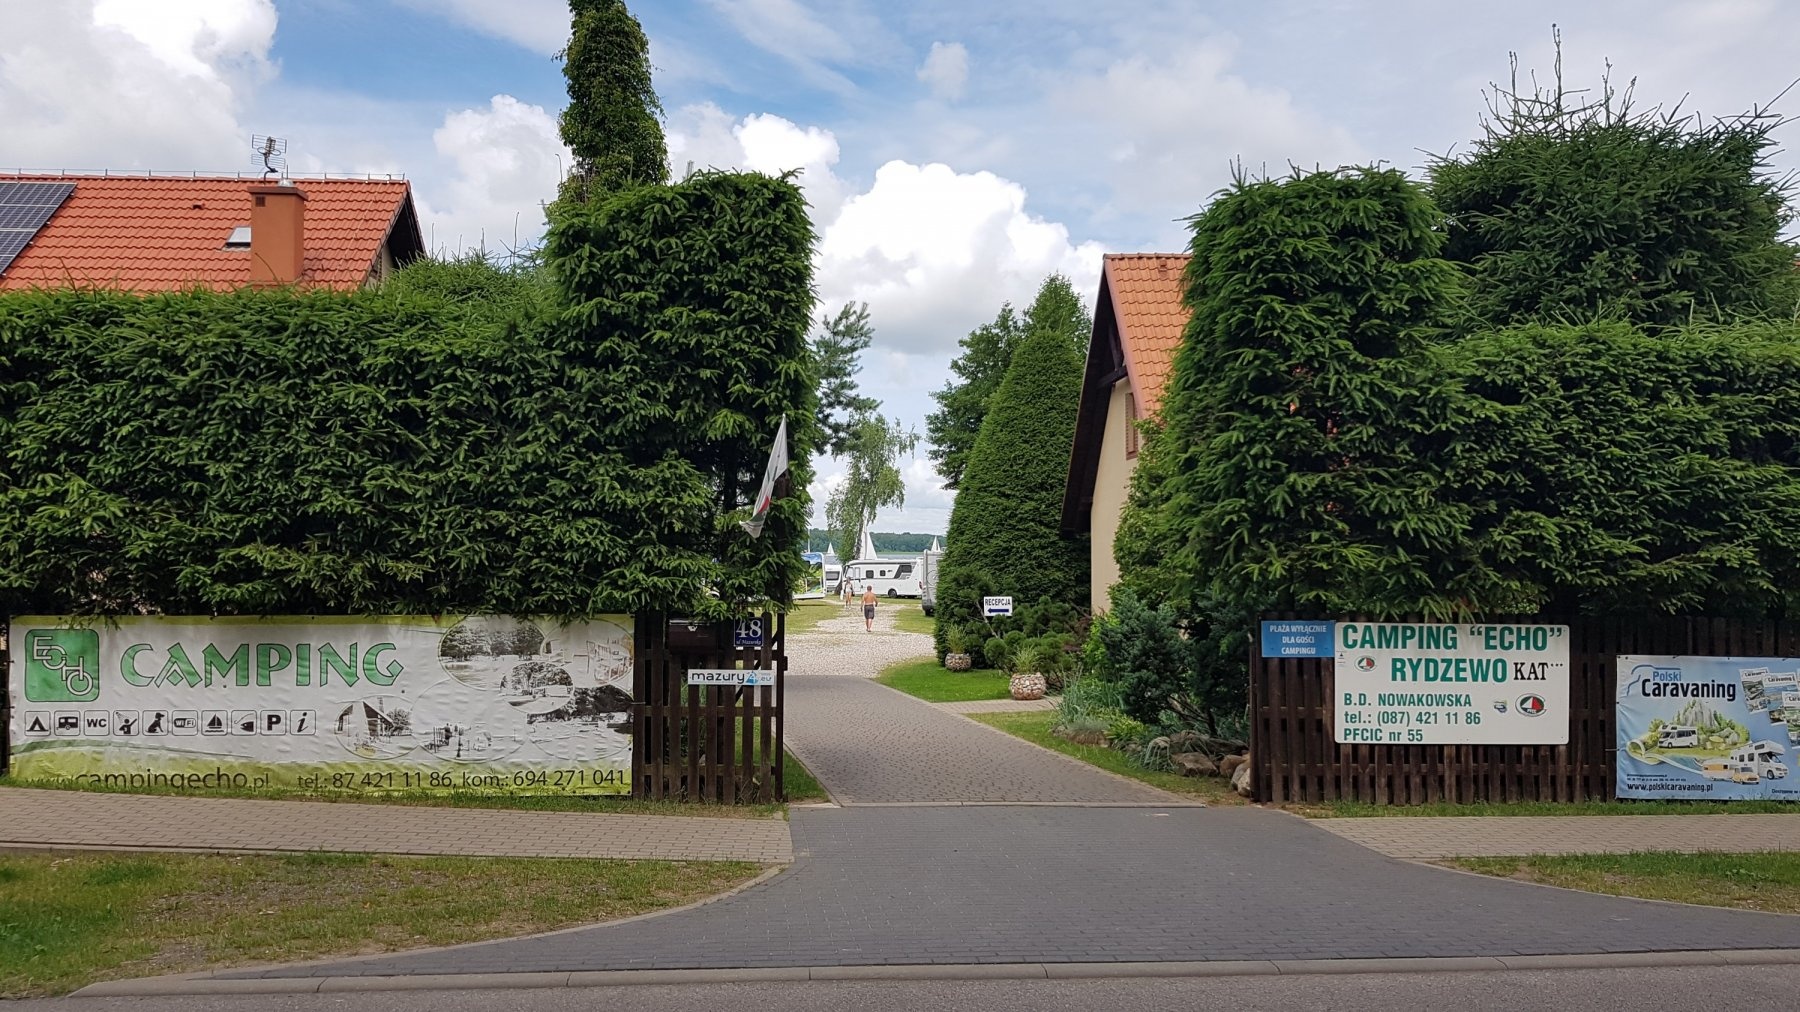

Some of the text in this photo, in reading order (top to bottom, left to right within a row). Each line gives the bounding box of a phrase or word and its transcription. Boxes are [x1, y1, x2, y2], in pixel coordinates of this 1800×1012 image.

[985, 598, 1011, 606] RECEPCJA
[736, 618, 762, 638] 48
[1282, 636, 1295, 644] DLA
[1342, 624, 1458, 650] CAMPING
[1281, 647, 1316, 655] CAMPINGU
[33, 635, 94, 696] ECHO
[120, 642, 404, 688] CAMPING
[1391, 658, 1507, 683] RYDZEWO
[691, 672, 745, 684] mazury
[1652, 671, 1682, 682] Polski
[1641, 679, 1736, 701] Caravaning
[1343, 693, 1472, 707] B.D. NOWAKOWSKA
[86, 718, 107, 728] WC
[267, 714, 281, 731] P
[1344, 711, 1481, 726] tel.: (087) 421 11 86
[1344, 728, 1423, 741] PFCIC nr 55
[297, 769, 624, 788] tel.: 87 421 11 86, kom.: 694 271 041
[1627, 783, 1714, 792] www.polskicaravaning.pl
